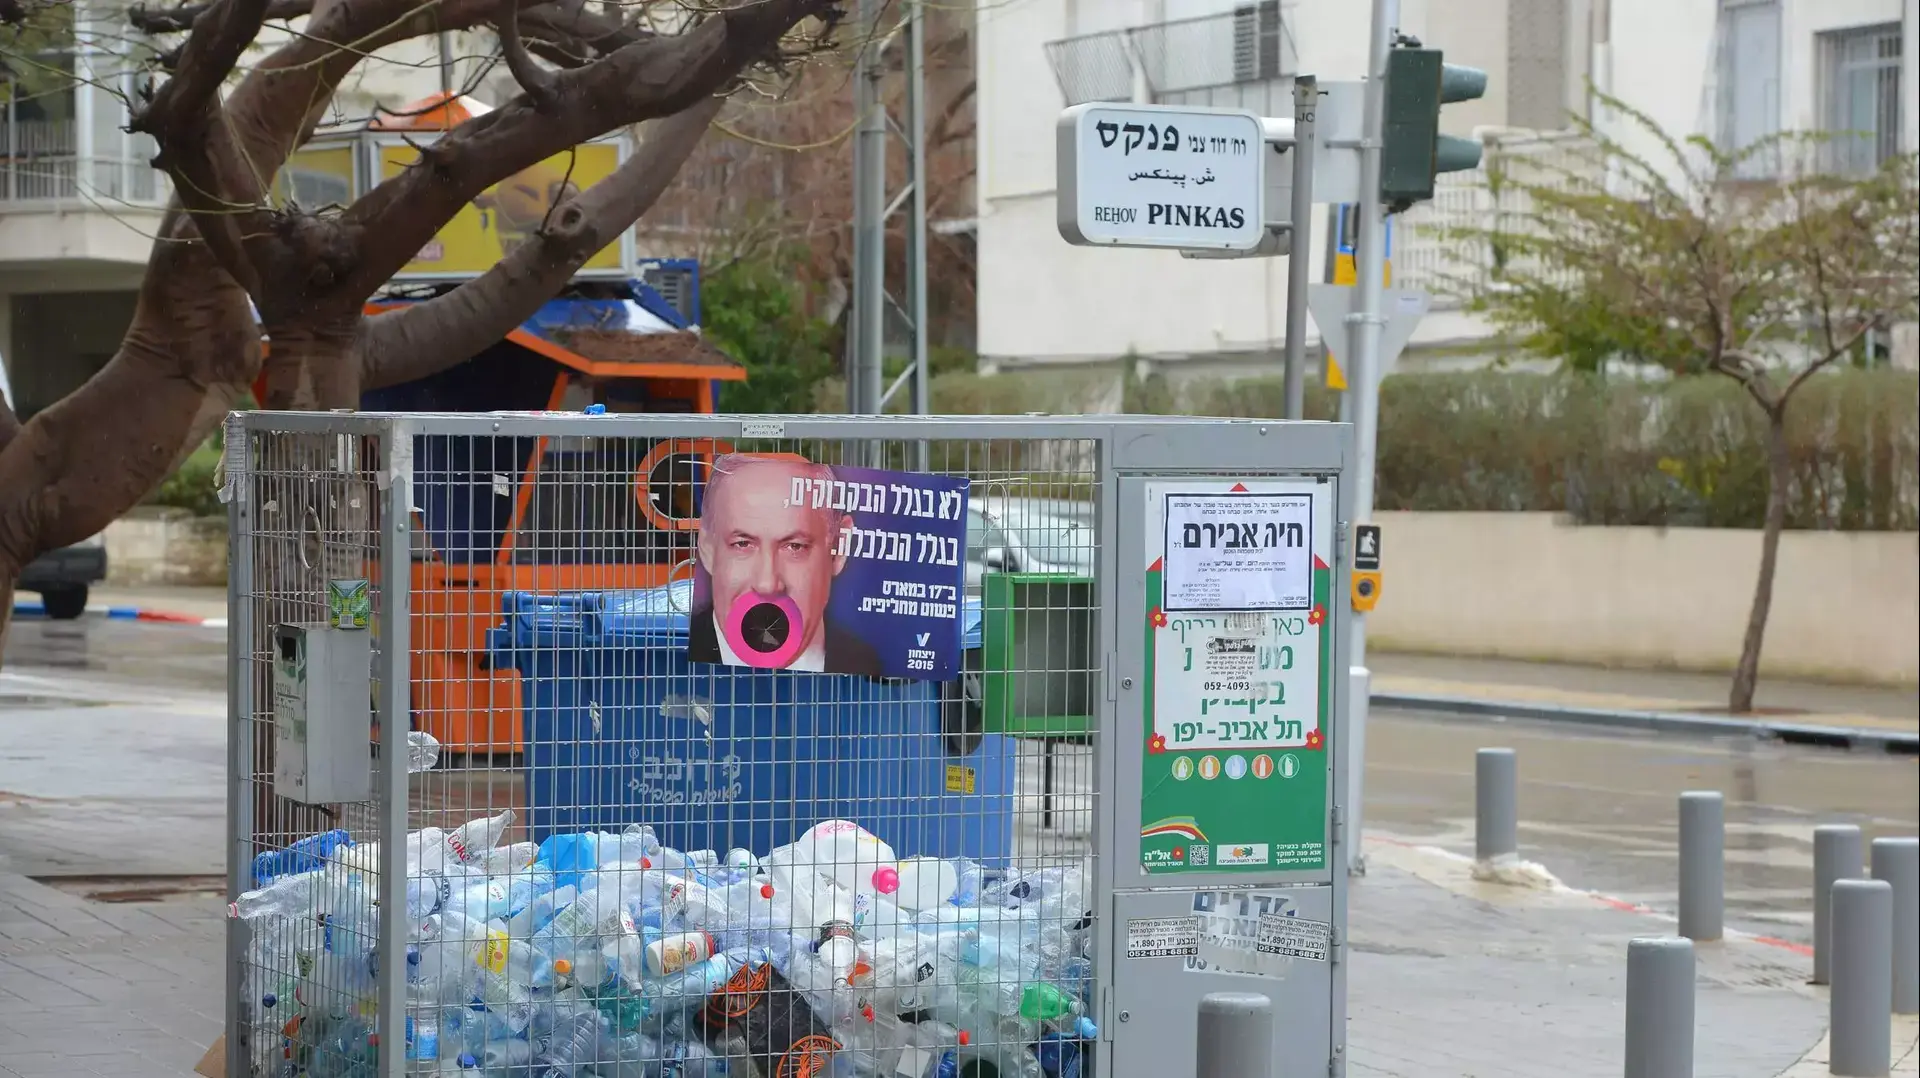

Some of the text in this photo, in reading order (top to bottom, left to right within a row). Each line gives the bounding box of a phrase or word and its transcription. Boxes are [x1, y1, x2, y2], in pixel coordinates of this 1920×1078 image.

[1096, 119, 1180, 156] פנקס
[1188, 135, 1206, 153] צבי
[1210, 137, 1226, 154] דוד
[1148, 203, 1245, 229] PINKAS
[783, 476, 962, 521] לא בגלל הבקבוקים,
[830, 526, 959, 566] בגלל הכלכלה.
[1183, 522, 1258, 548] אבירם
[1263, 522, 1303, 548] חיה
[882, 580, 926, 598] במארס
[857, 596, 956, 619] פשוט מחליפים.
[1272, 618, 1305, 643] כאן
[907, 659, 934, 671] 2015
[908, 649, 935, 661] ניצחון
[1274, 715, 1302, 740] תל
